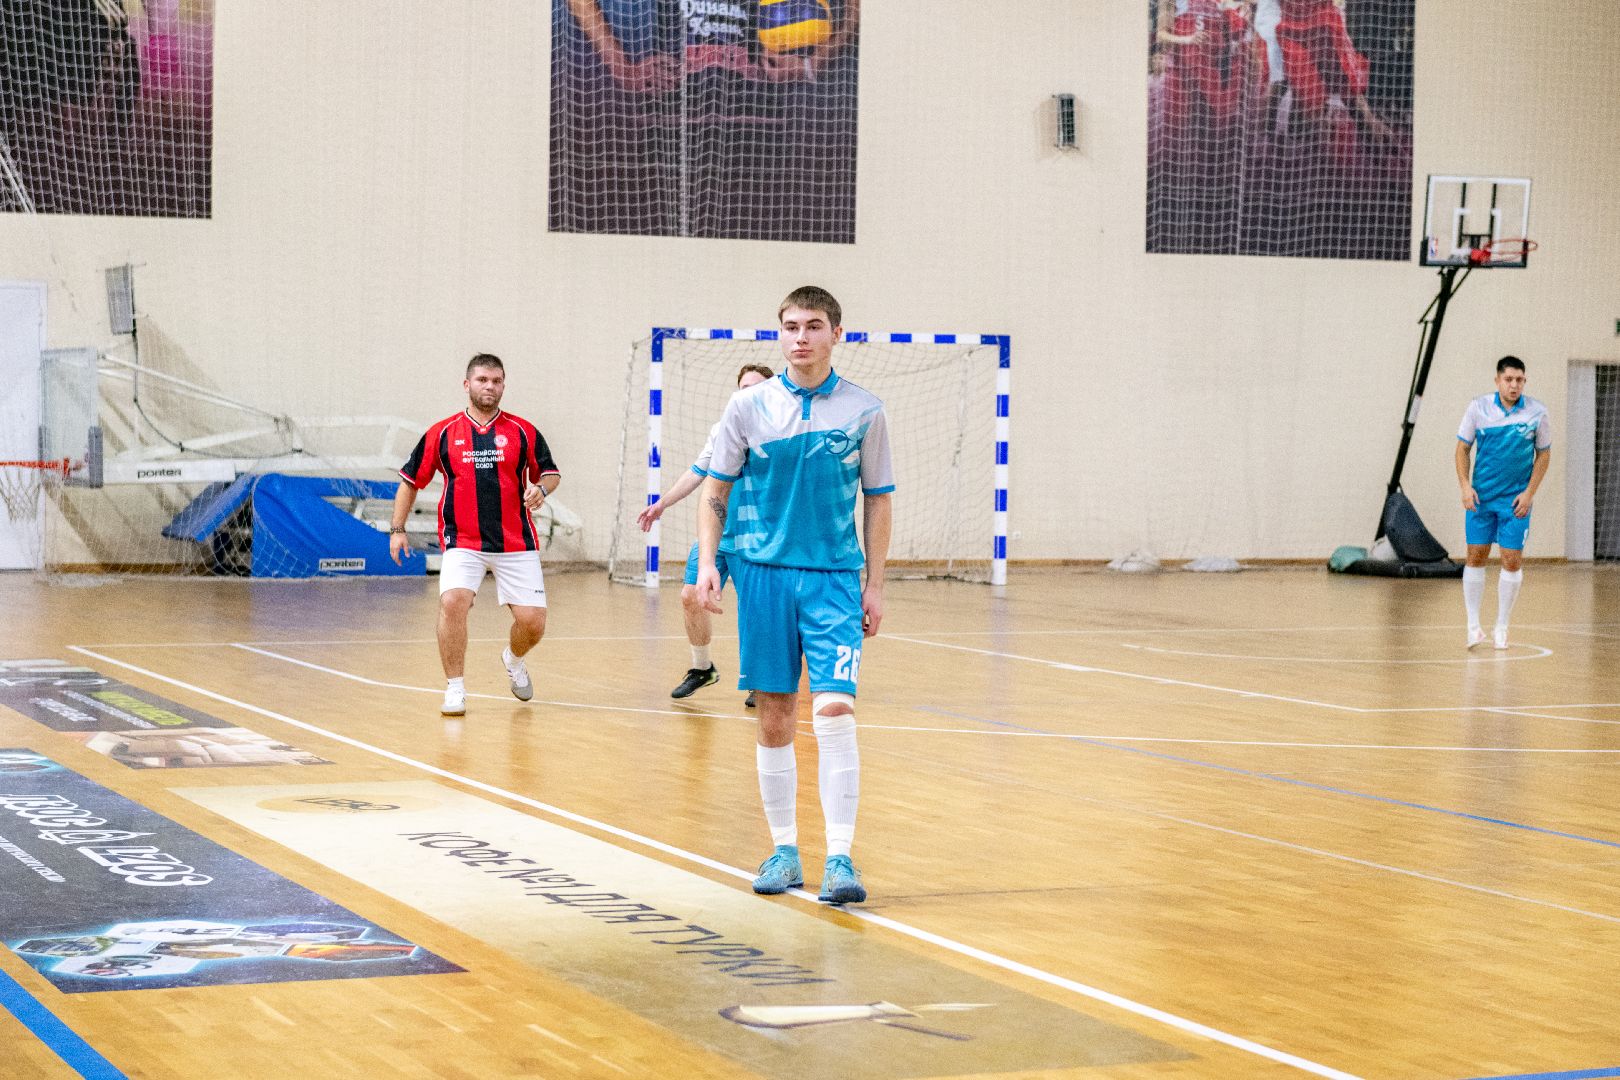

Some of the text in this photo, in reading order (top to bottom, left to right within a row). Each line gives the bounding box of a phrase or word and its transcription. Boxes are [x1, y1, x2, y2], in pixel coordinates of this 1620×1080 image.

[462, 449, 504, 457] РОССИЙСКИЙ
[462, 454, 505, 463] ФУТБОЛЬНЫЙ
[137, 468, 182, 479] porter
[320, 559, 364, 569] porter
[397, 831, 537, 867] КОФЕ
[525, 893, 682, 924] ДЛЯ
[629, 924, 837, 987] ТУРКИ
